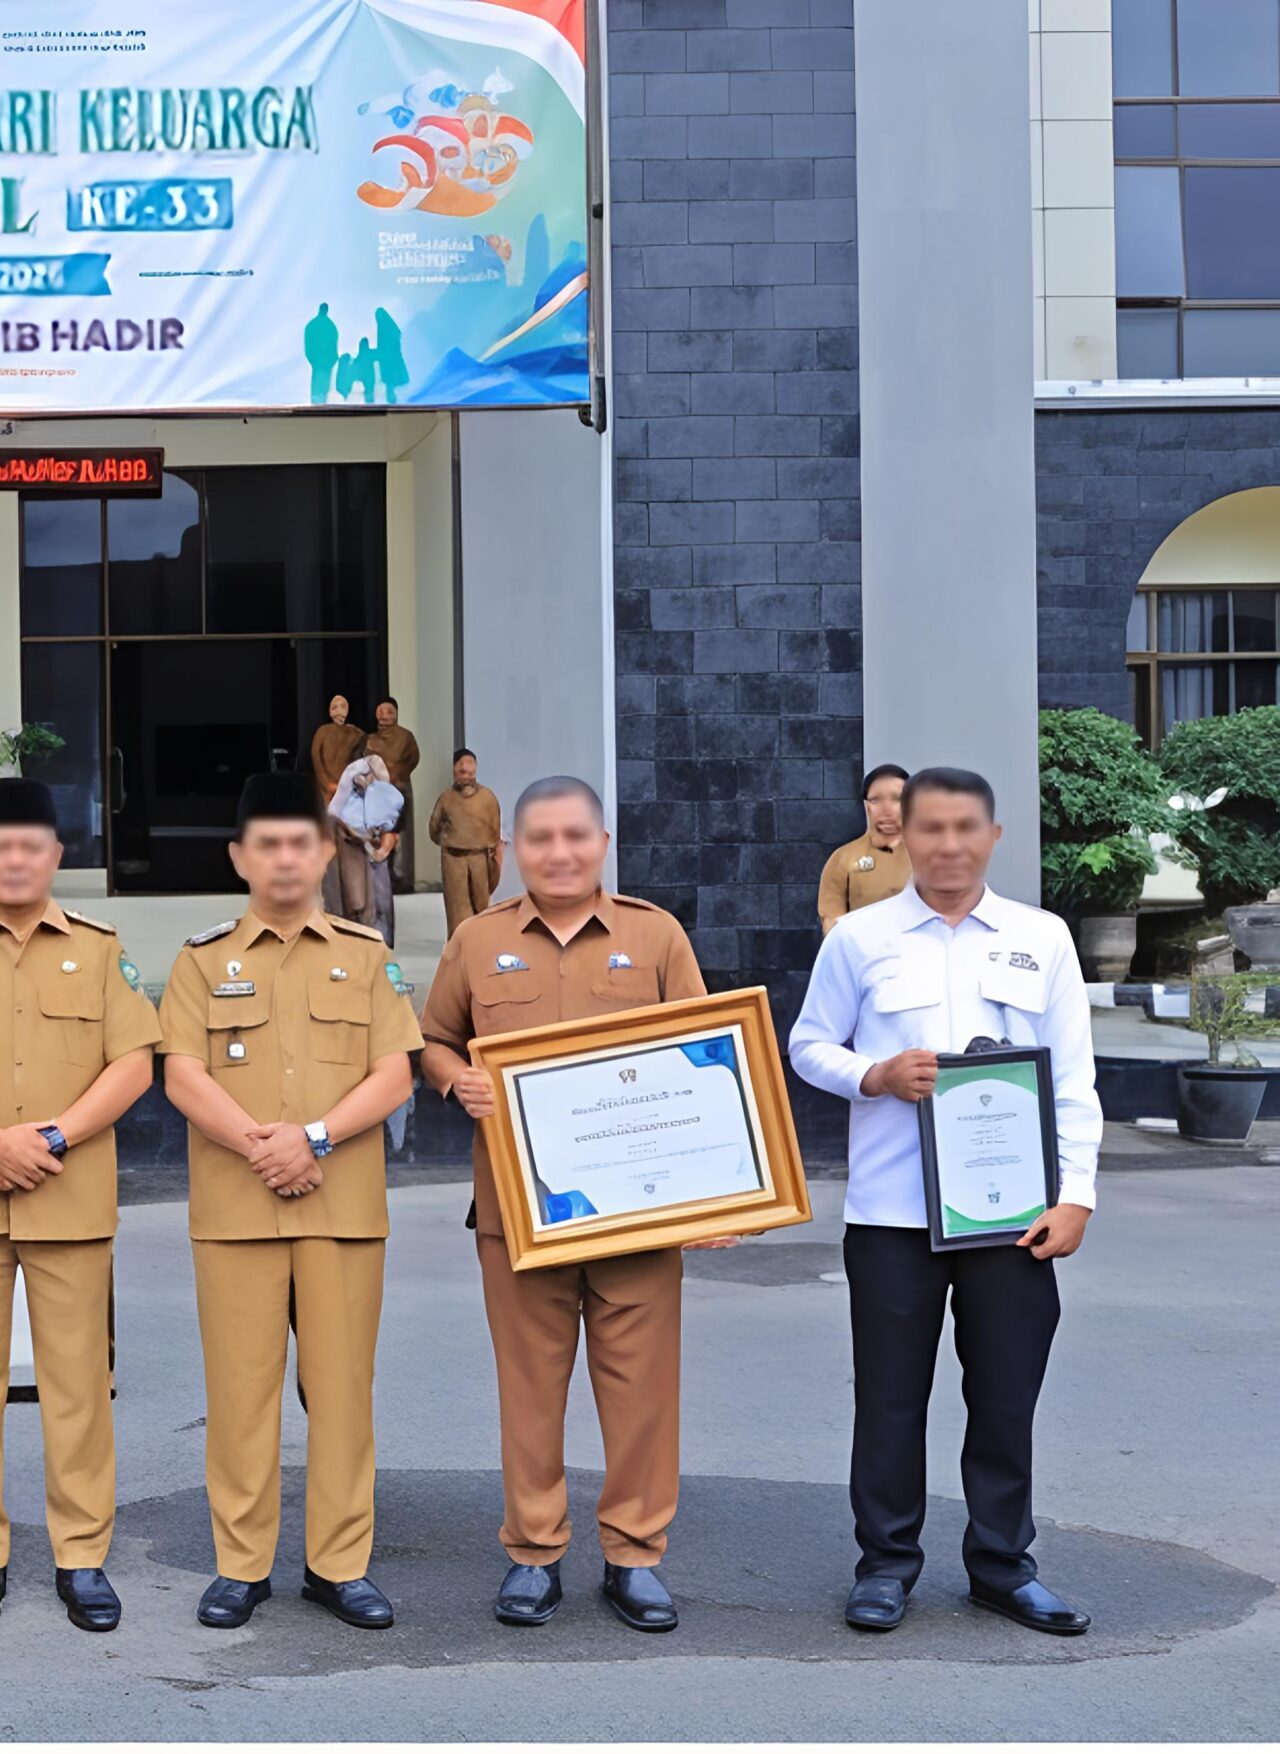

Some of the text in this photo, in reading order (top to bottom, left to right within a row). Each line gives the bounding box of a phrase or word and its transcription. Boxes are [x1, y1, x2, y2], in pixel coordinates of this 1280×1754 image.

[78, 84, 319, 153] KELUARGA
[81, 185, 219, 227] KE-33
[51, 317, 185, 352] HADIR
